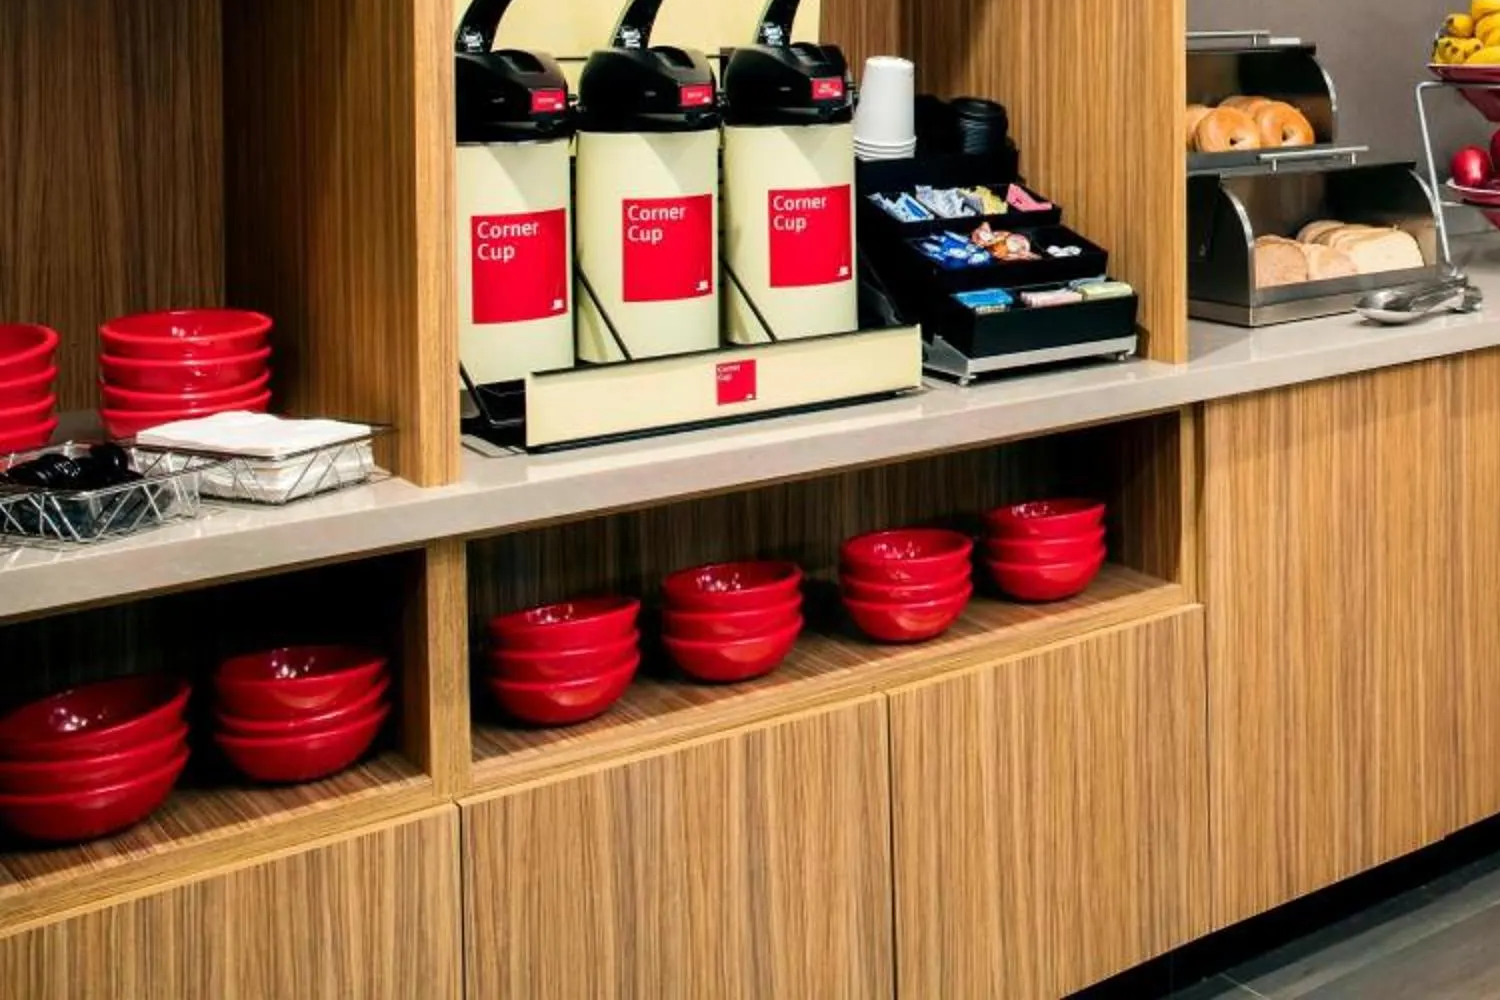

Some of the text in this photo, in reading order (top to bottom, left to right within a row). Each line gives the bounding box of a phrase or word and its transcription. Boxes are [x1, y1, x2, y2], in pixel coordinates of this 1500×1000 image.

[773, 195, 827, 211] Corner
[627, 205, 686, 221] Corner
[477, 221, 539, 239] Corner
[773, 215, 807, 232] Cup
[627, 226, 664, 245] Cup
[477, 243, 516, 263] Cup
